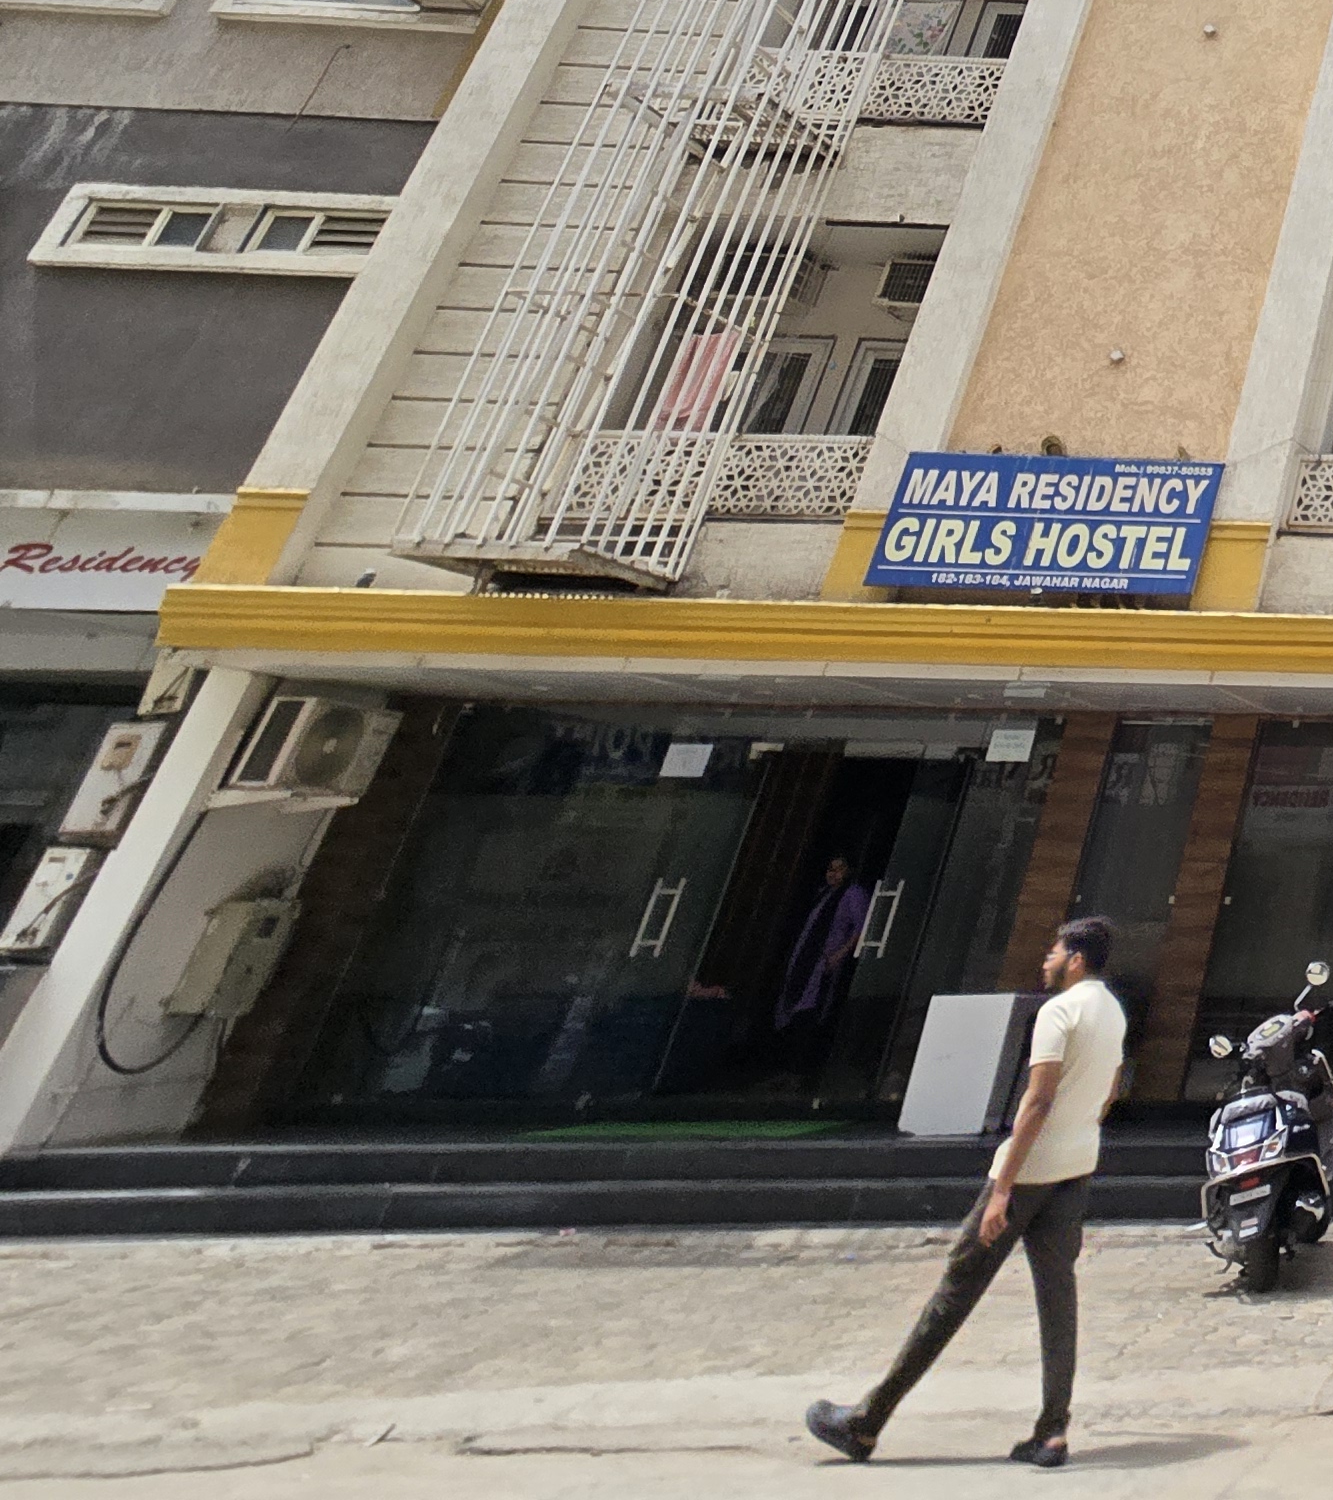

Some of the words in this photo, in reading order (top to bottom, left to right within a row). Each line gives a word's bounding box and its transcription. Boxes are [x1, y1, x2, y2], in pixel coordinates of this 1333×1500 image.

[903, 469, 998, 508] MAYA
[1008, 472, 1208, 514] RESIDENCY
[885, 517, 1017, 565] GIRLS
[1023, 523, 1191, 571] HOSTEL
[931, 573, 1010, 586] 182-183-184,
[1014, 575, 1078, 587] JAWAHAR
[1082, 577, 1128, 589] NAGAR
